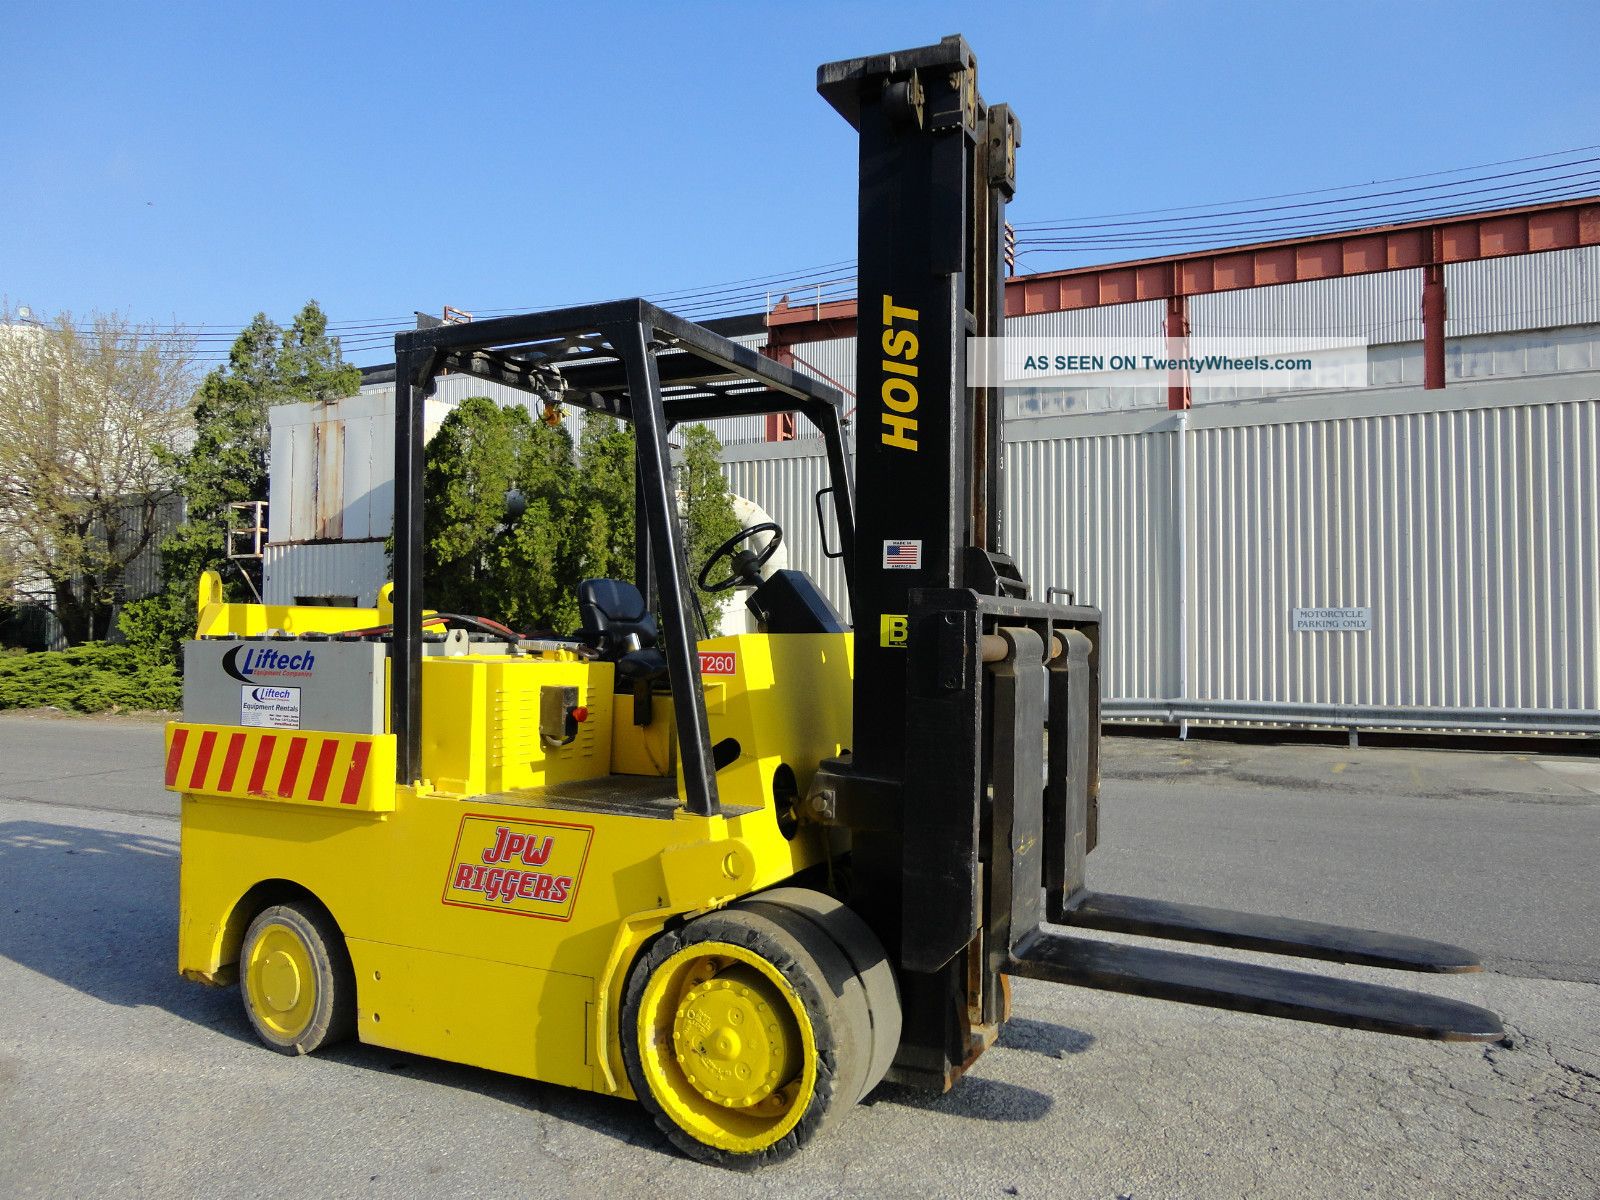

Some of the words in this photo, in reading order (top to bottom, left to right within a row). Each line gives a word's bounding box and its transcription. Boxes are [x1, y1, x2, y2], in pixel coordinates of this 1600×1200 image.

[881, 294, 919, 452] HOIST
[1300, 610, 1363, 618] MOTORCYCLE
[1297, 620, 1339, 628] PARKING
[1342, 620, 1367, 628] ONLY
[242, 648, 315, 675] Liftech
[260, 688, 290, 700] Liftech
[243, 702, 275, 711] Equipment
[275, 704, 299, 712] Rentals
[481, 825, 555, 867] JPW
[453, 862, 573, 904] RIGGERS
